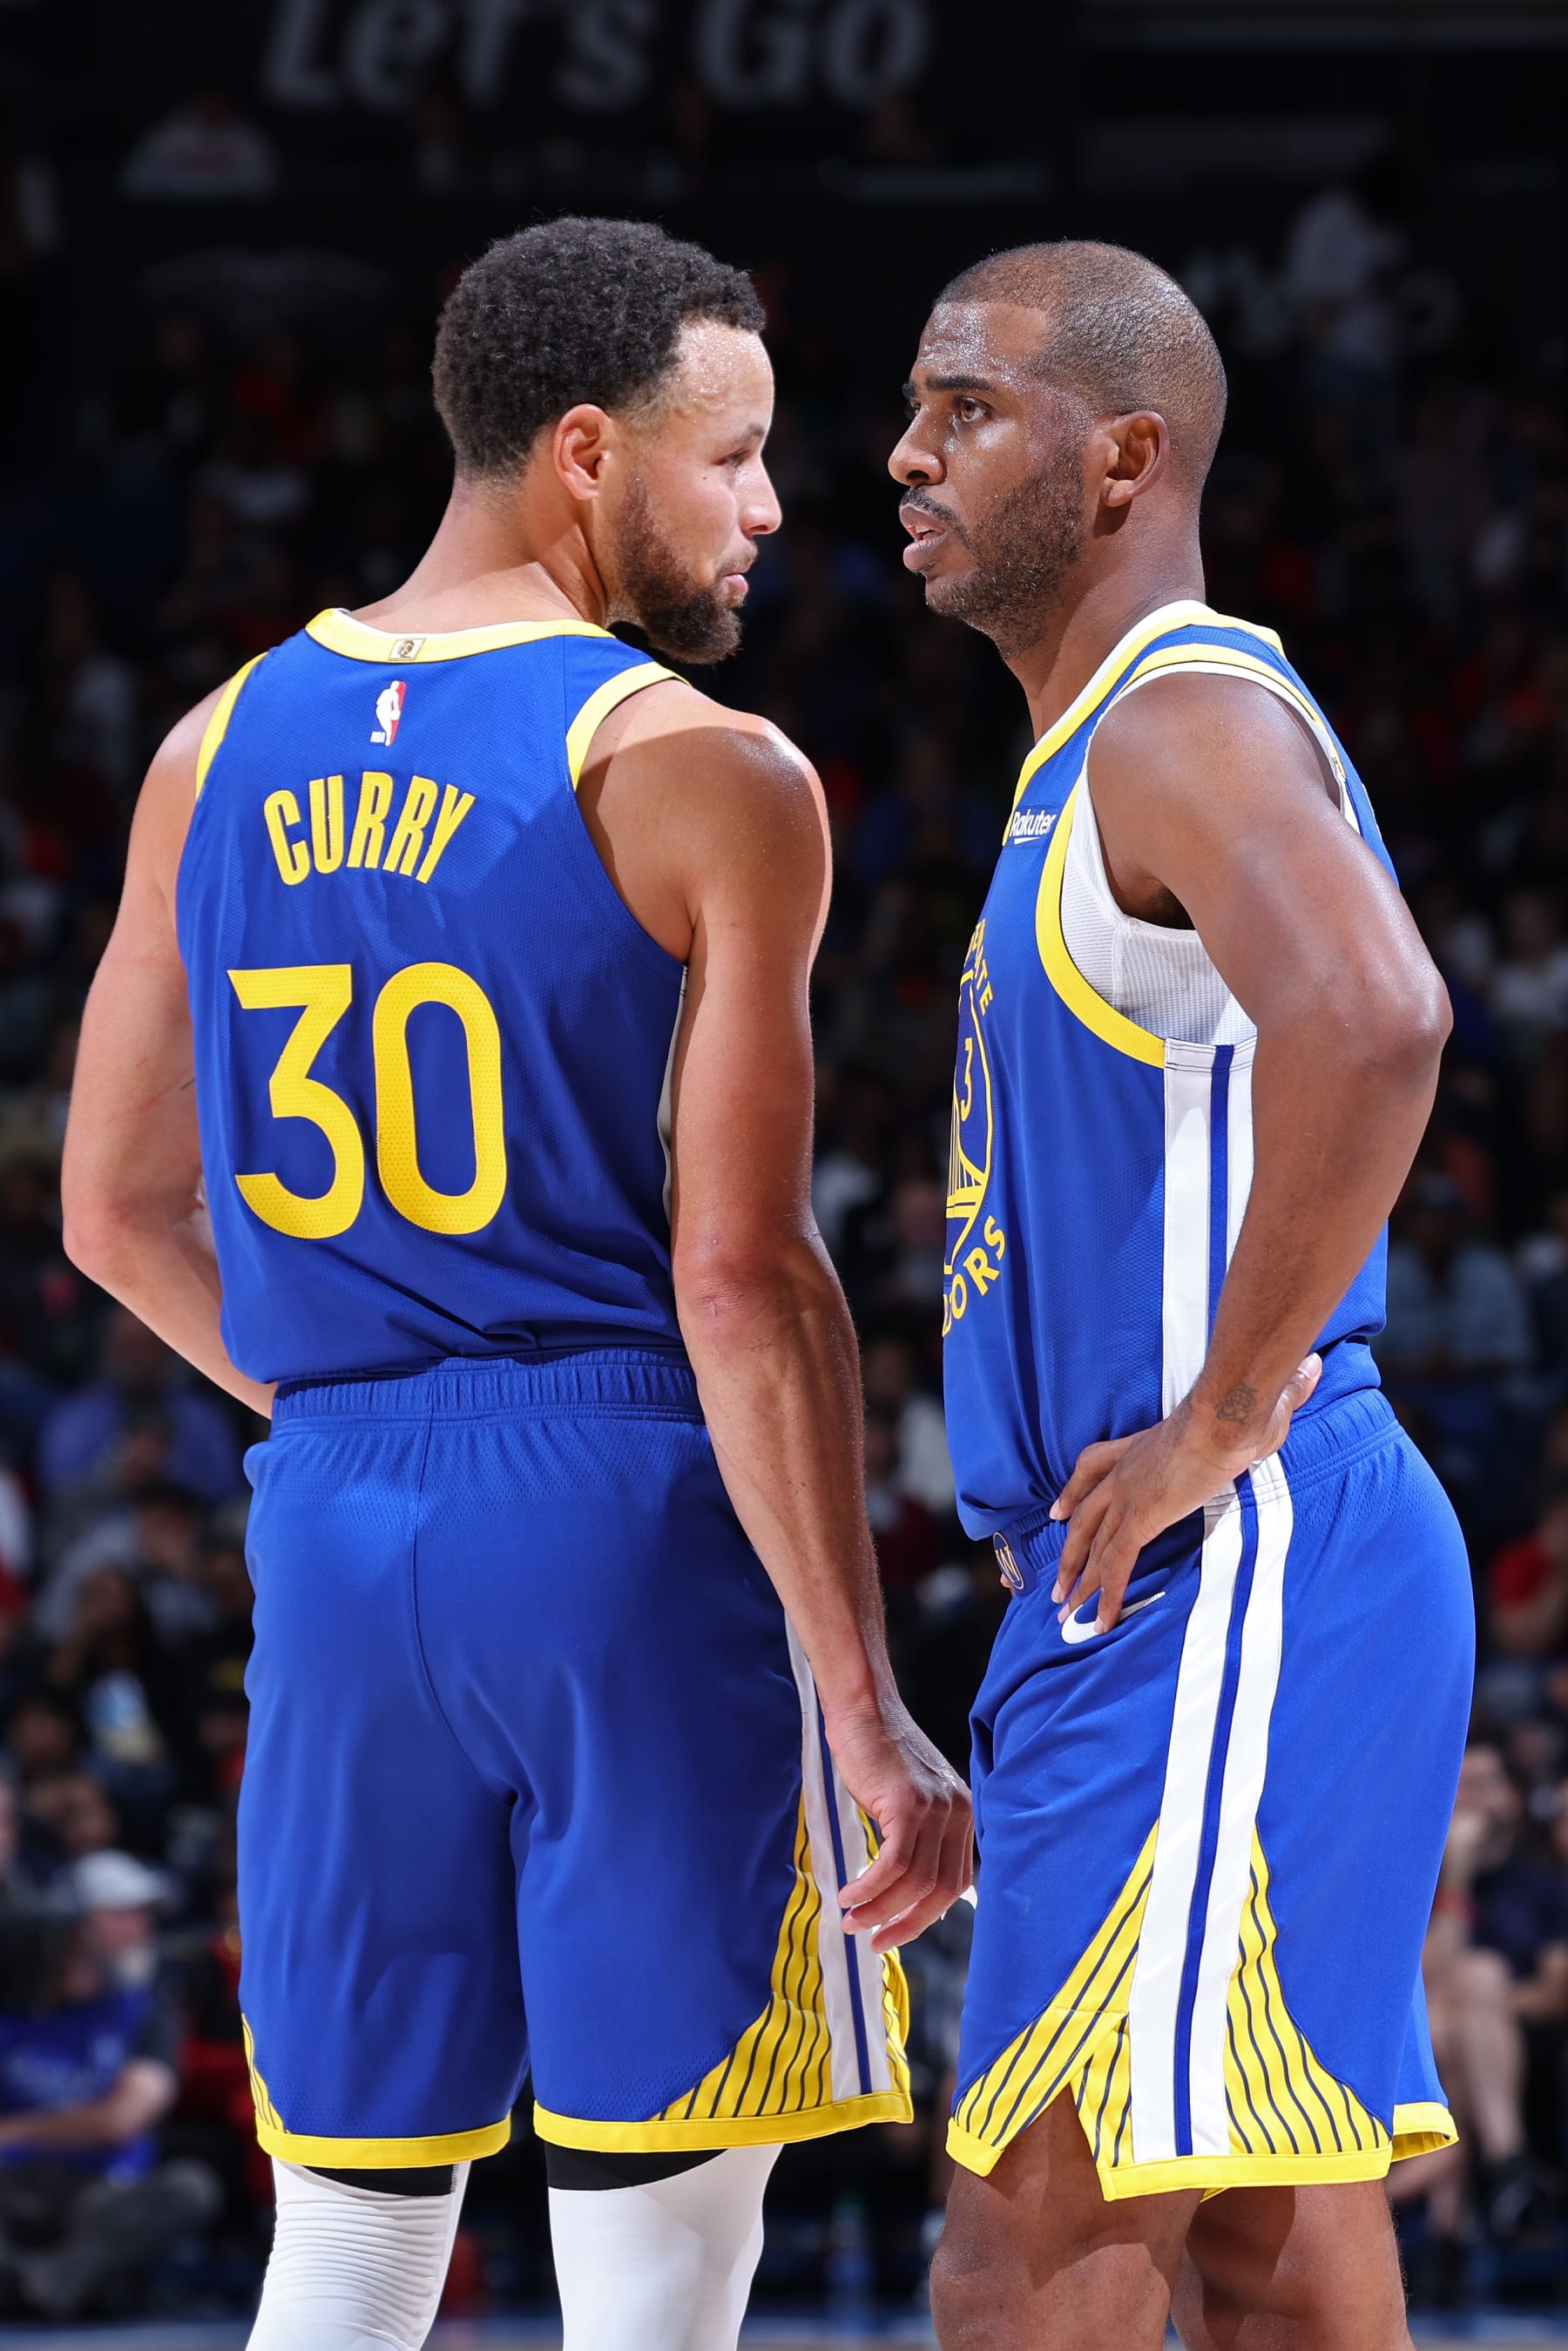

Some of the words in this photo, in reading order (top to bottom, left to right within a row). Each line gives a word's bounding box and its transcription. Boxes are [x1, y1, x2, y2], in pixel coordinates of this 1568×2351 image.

[258, 0, 659, 114] Lets
[263, 771, 476, 886] CURRY
[226, 962, 507, 1240] 30
